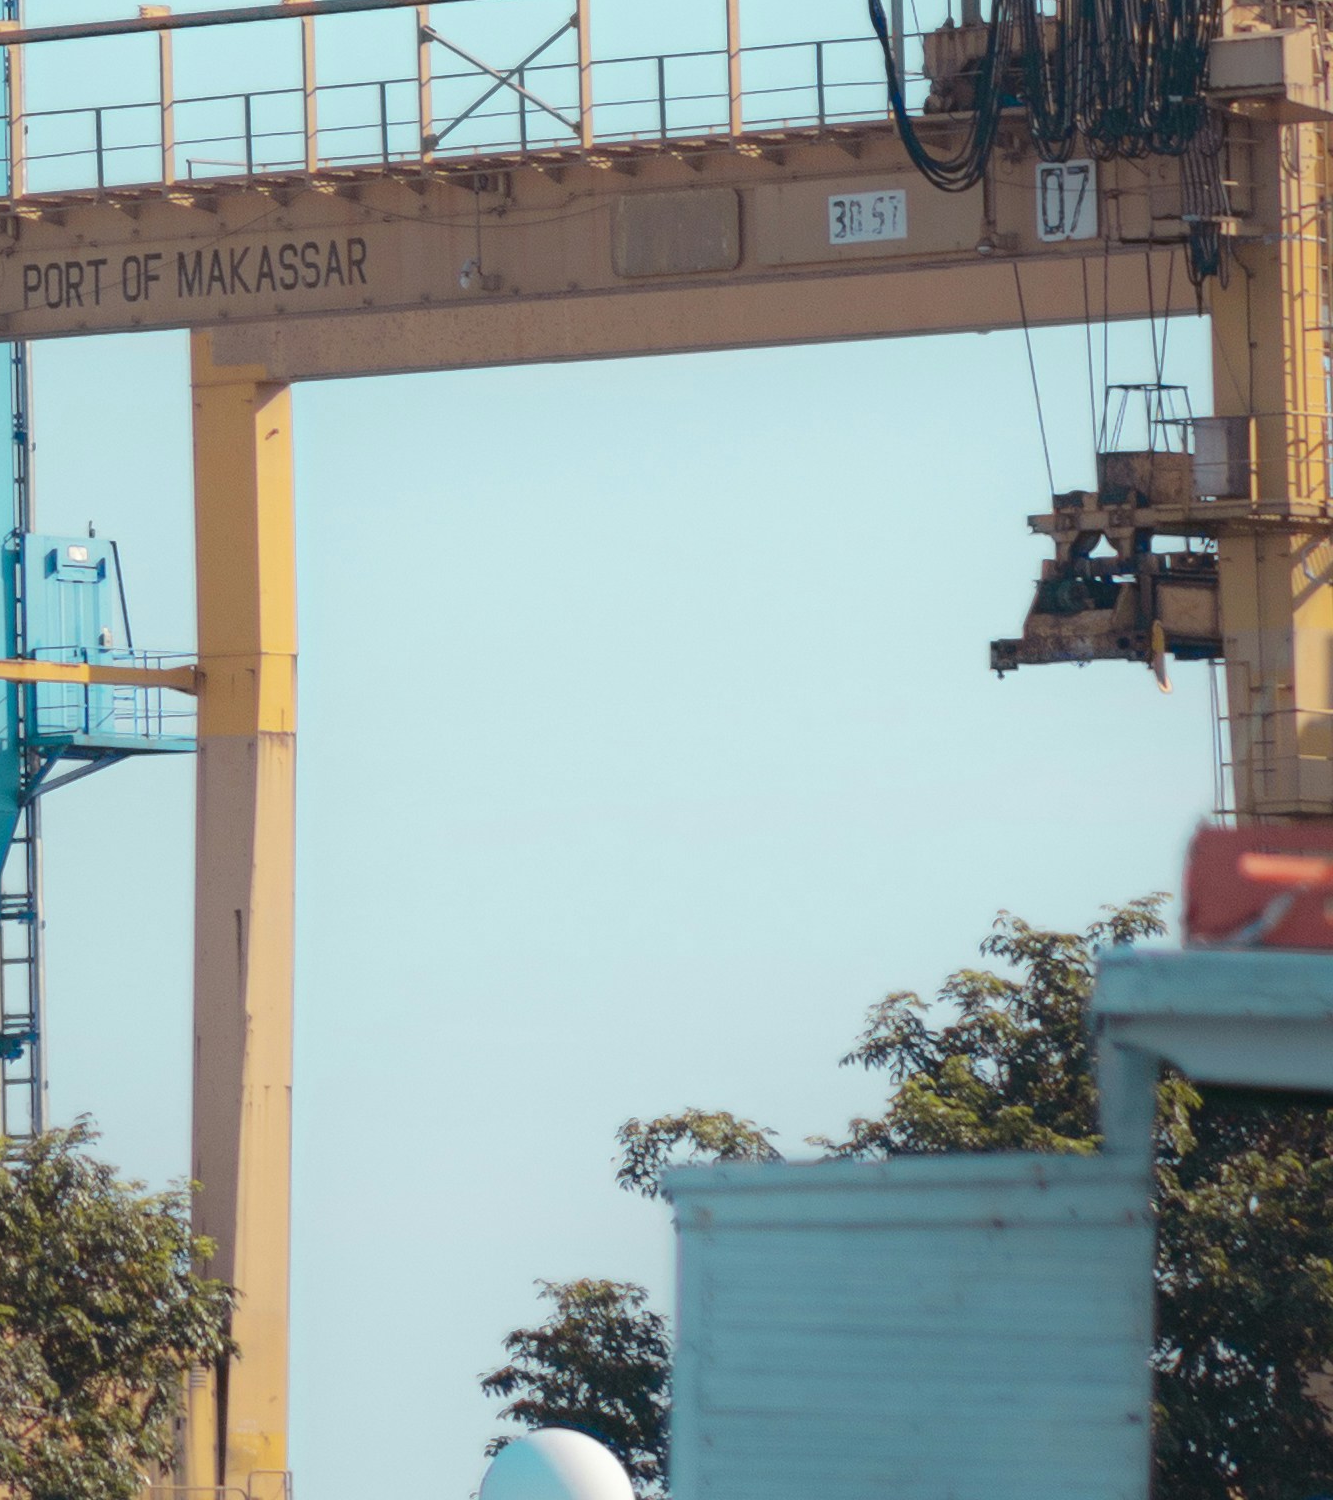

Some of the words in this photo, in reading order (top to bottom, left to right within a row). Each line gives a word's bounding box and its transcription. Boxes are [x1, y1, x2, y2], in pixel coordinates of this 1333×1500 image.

[1039, 165, 1090, 235] 07
[23, 258, 108, 310] PORT
[121, 253, 163, 303] OF
[177, 237, 368, 298] MAKASSAR
